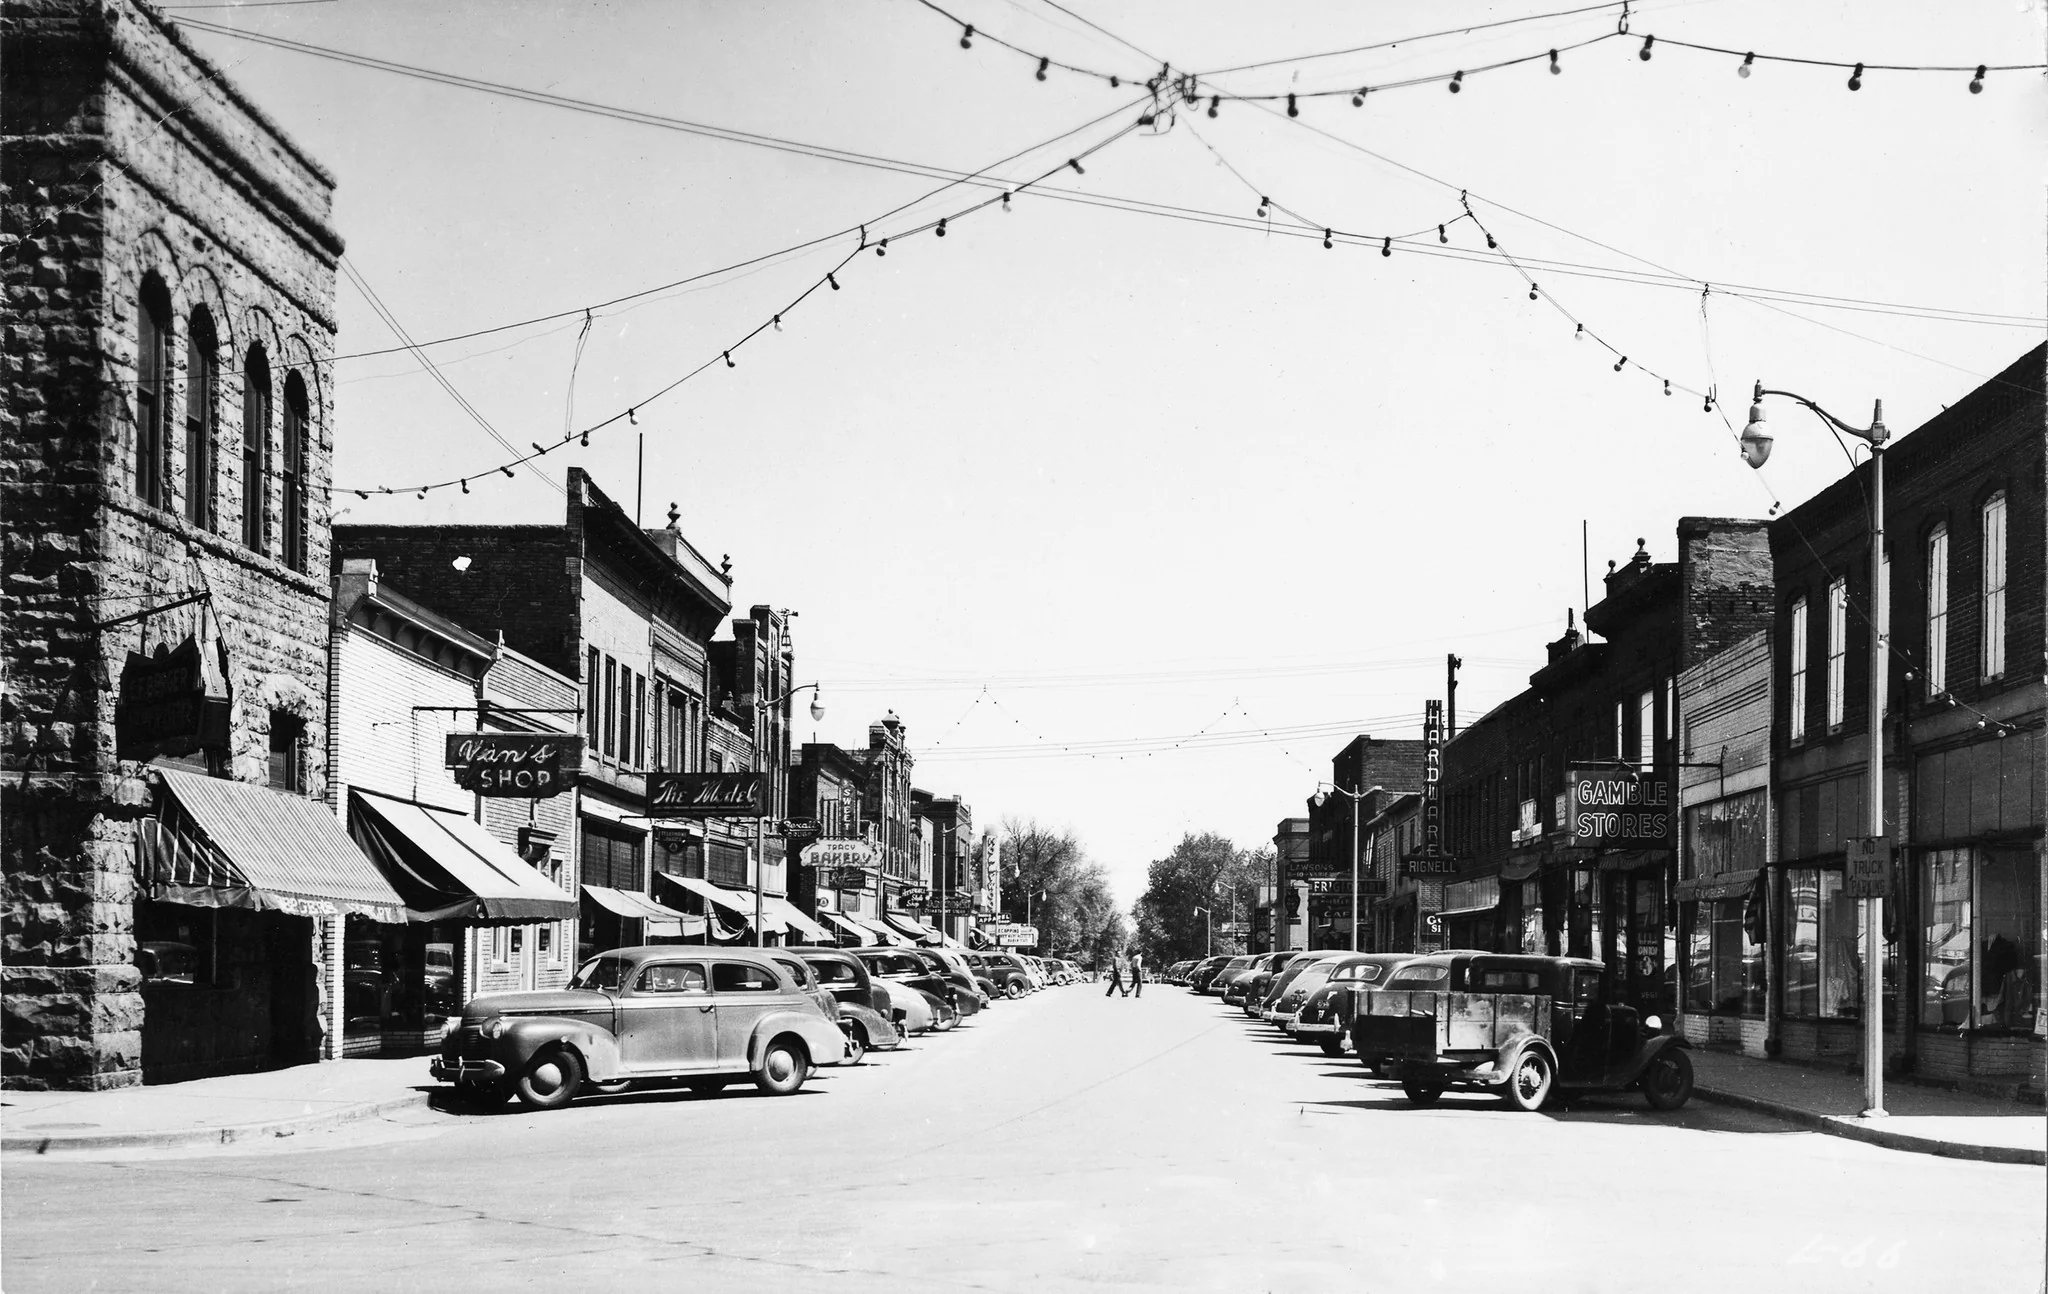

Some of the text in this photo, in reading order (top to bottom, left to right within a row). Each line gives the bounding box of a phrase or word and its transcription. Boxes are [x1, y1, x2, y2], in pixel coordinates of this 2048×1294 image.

[458, 739, 557, 764] Van's
[481, 769, 551, 788] SHOP
[1426, 707, 1440, 858] HARDWARE
[652, 779, 760, 807] The Model
[1577, 780, 1668, 806] GAMBLE
[842, 788, 851, 831] SWEET
[783, 819, 818, 830] Rexall
[1577, 812, 1668, 838] STORES
[1862, 841, 1876, 855] NO
[811, 852, 872, 864] BAKERY
[1408, 860, 1457, 873] RIGNELL
[1289, 864, 1335, 872] LAWSONS
[1853, 859, 1885, 875] TRUCK
[1851, 879, 1885, 894] PARKING
